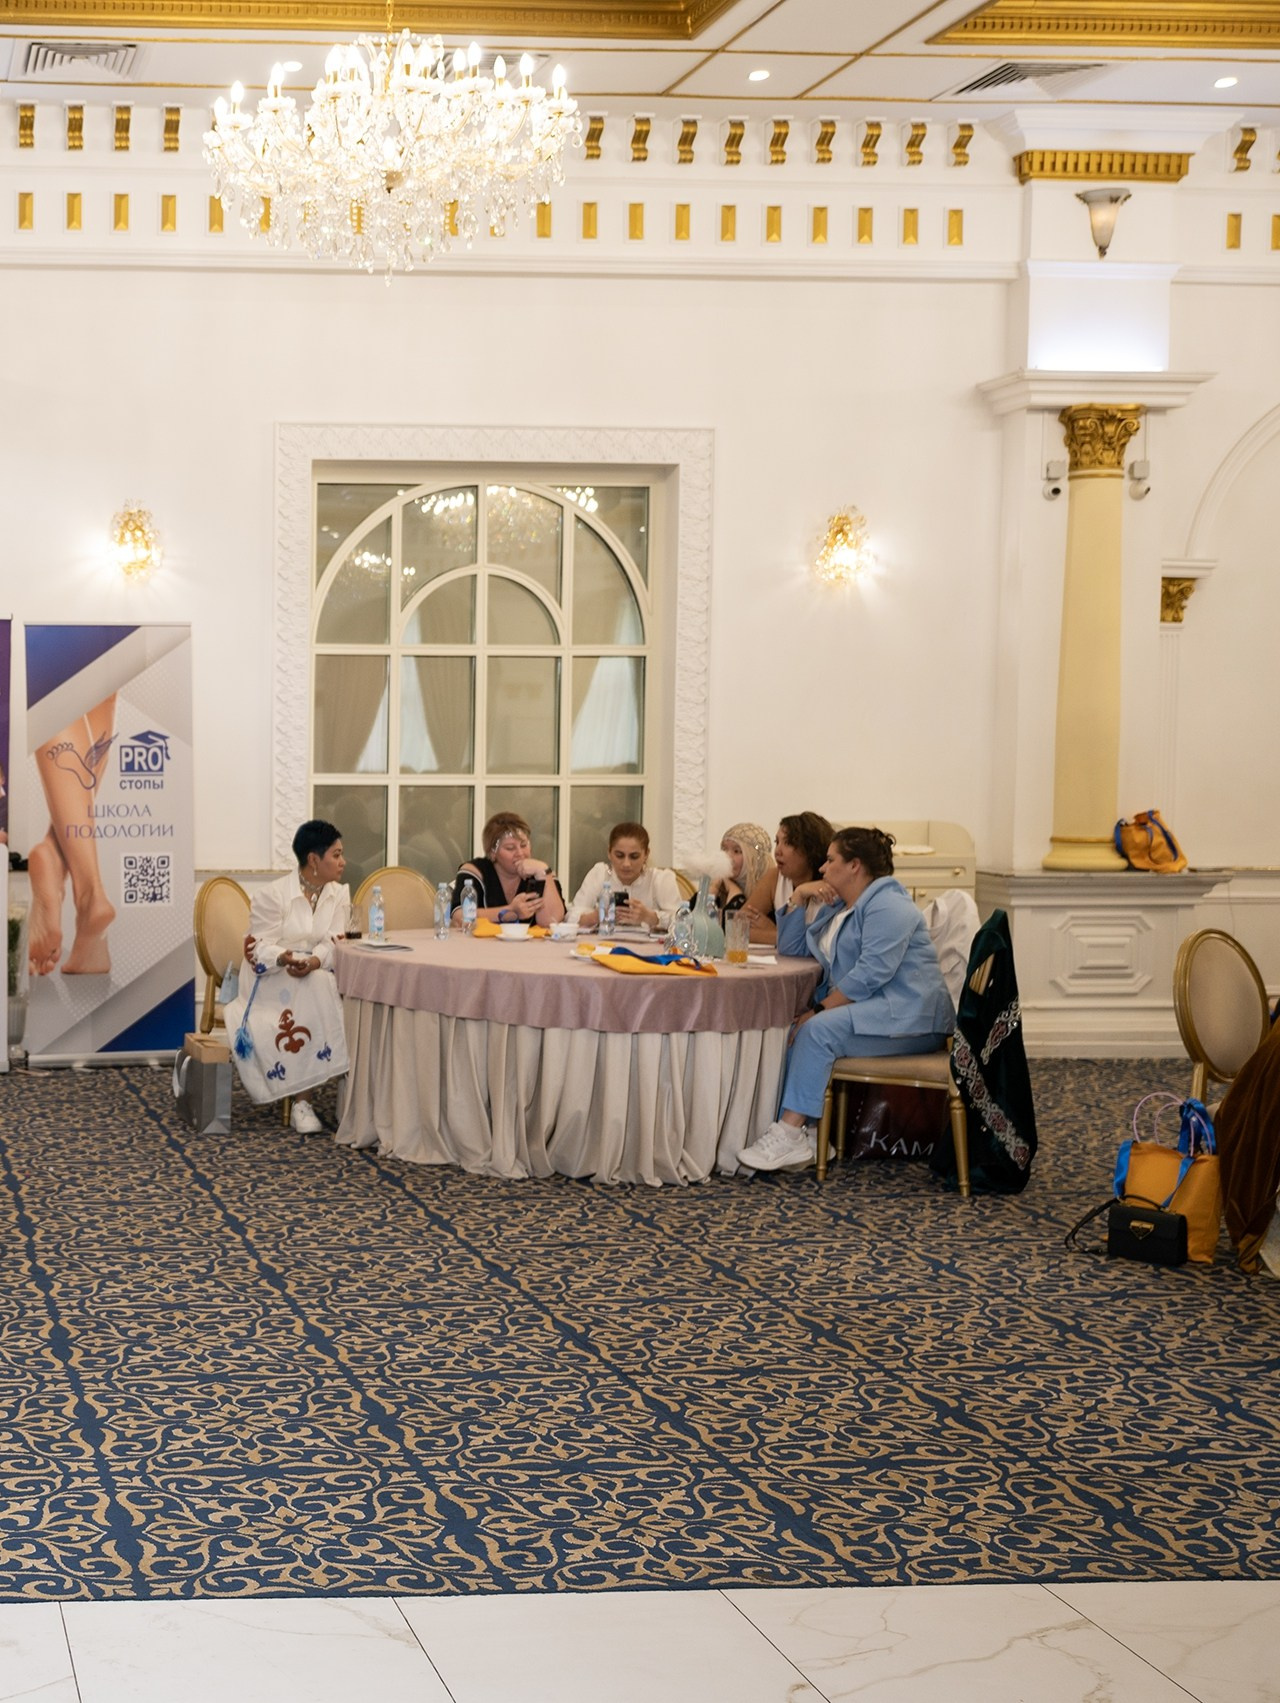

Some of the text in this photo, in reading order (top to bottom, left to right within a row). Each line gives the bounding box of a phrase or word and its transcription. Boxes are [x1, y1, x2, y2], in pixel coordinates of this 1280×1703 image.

[121, 746, 163, 771] PRO
[87, 804, 152, 818] ШКОЛА
[66, 824, 174, 839] ПОДОЛОГИИ
